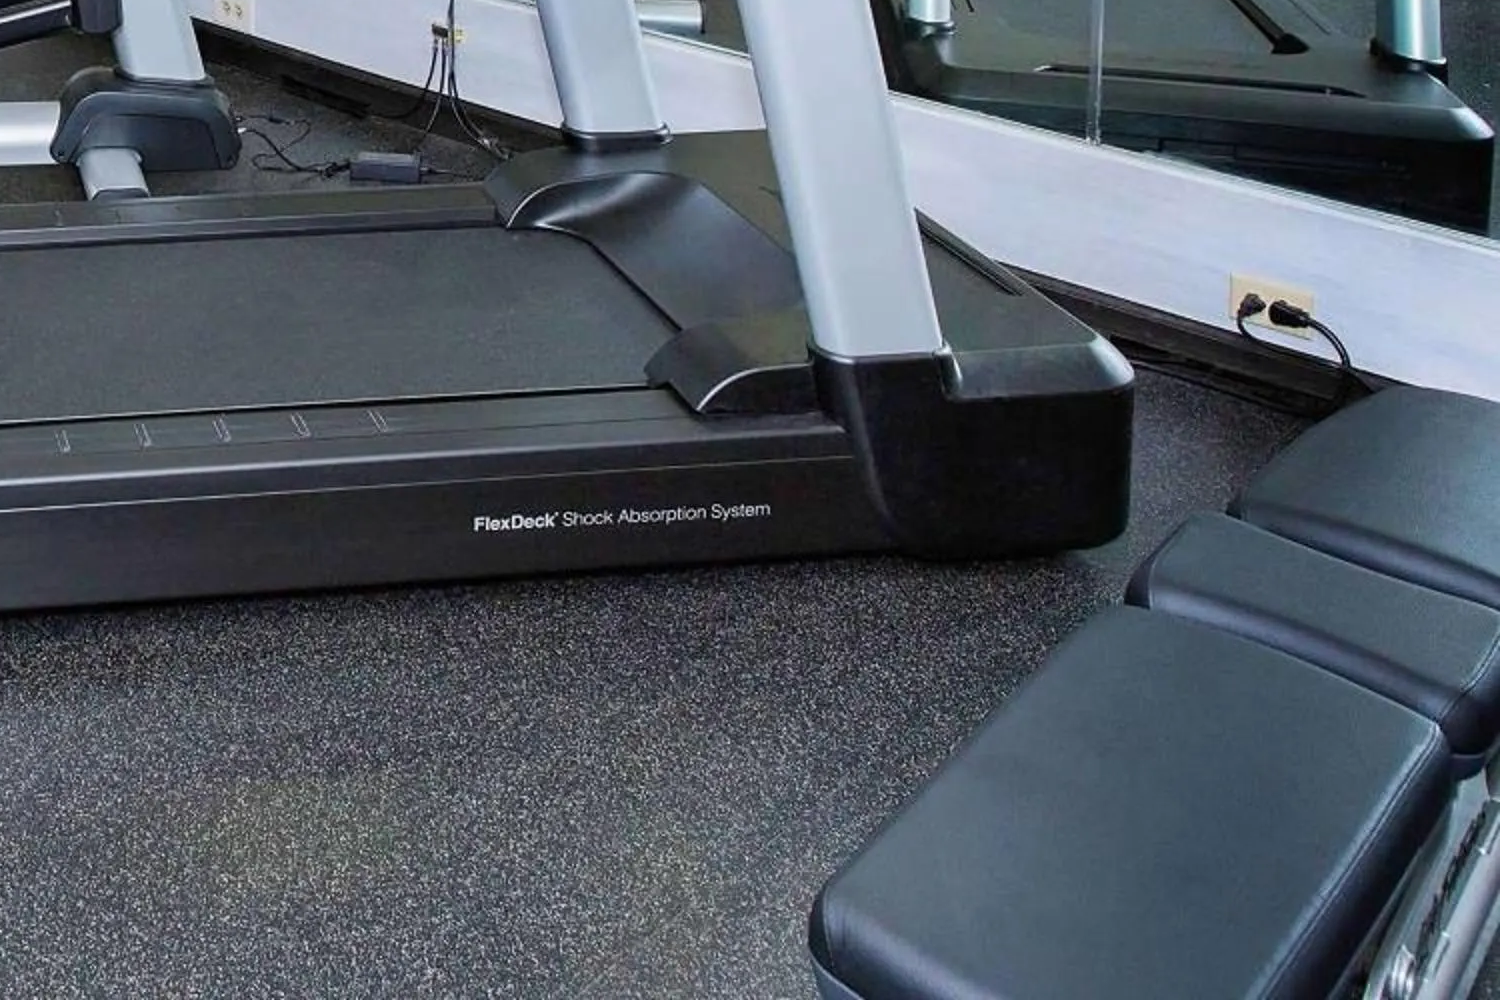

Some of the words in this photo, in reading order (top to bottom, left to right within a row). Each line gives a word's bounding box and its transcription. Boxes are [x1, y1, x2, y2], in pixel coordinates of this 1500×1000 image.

[561, 510, 614, 527] Shock
[617, 504, 707, 525] Absorption
[710, 502, 772, 521] System
